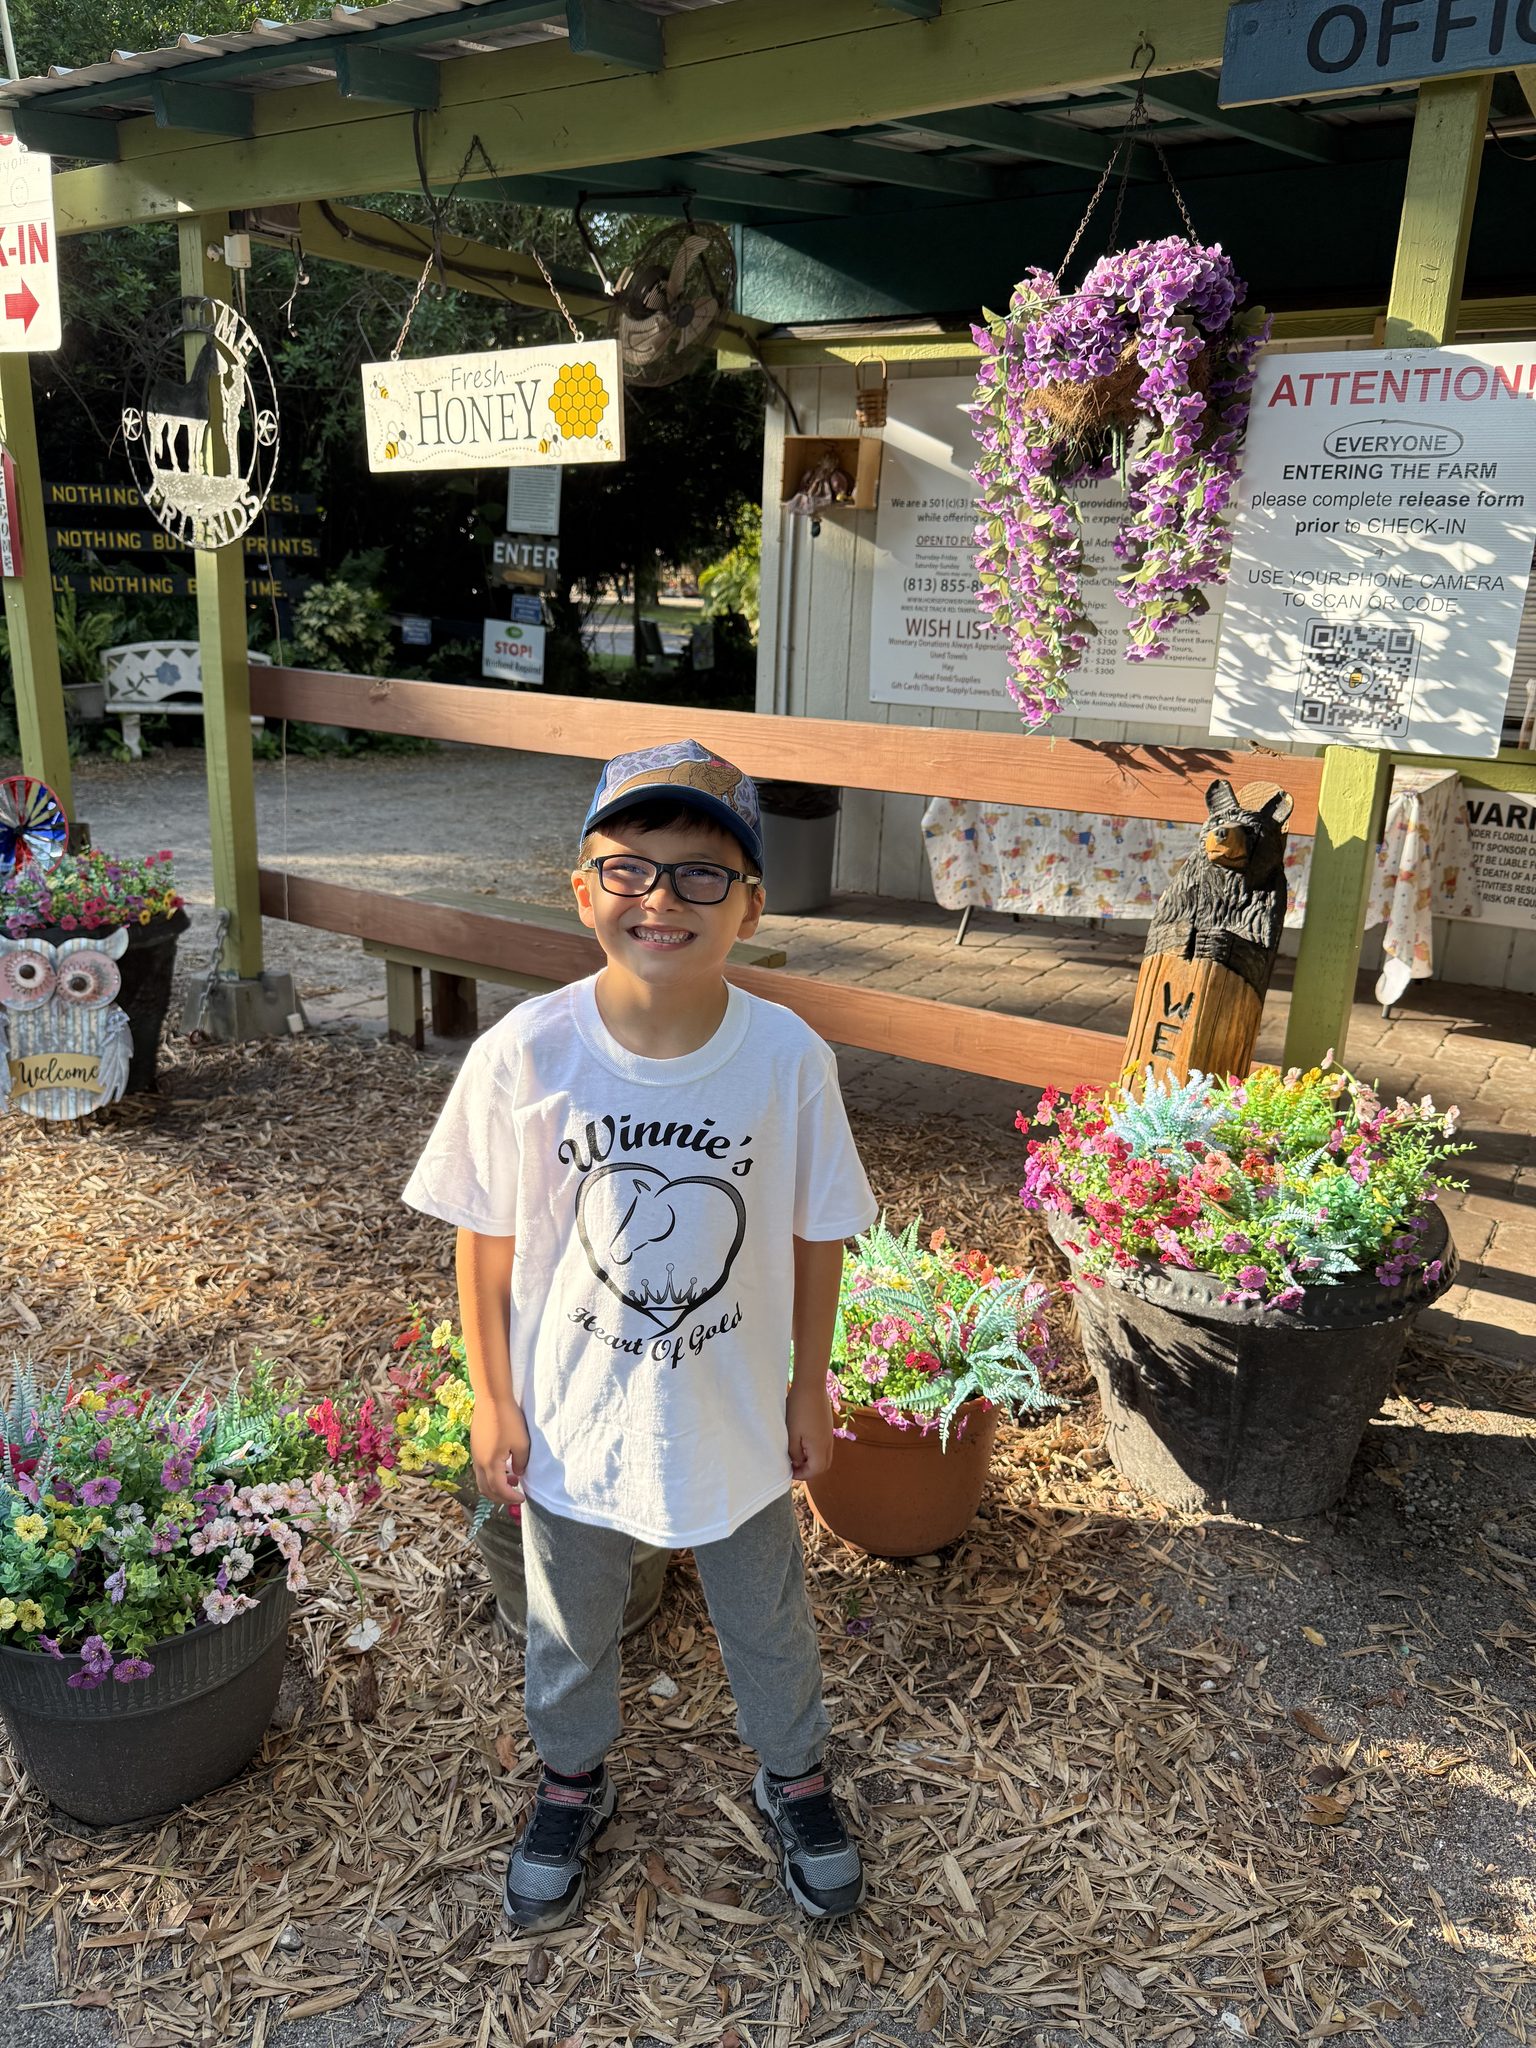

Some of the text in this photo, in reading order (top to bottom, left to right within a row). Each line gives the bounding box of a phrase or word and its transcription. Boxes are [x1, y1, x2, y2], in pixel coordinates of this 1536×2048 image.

[451, 360, 506, 391] Fresh
[1267, 364, 1536, 408] ATTENTION!
[414, 379, 542, 446] HONEY
[1335, 435, 1448, 453] EVERYONE
[1283, 462, 1498, 480] ENTERING THE FARM
[52, 485, 139, 506] NOTHING
[1251, 491, 1525, 509] please complete release form
[1081, 499, 1129, 511] providing
[917, 514, 942, 523] while
[943, 514, 978, 526] offering
[1295, 518, 1467, 535] prior to CHECK-IN
[57, 530, 142, 549] NOTHING
[916, 535, 946, 546] OPEN
[947, 536, 958, 546] TO
[493, 541, 559, 570] ENTER
[90, 576, 174, 595] NOTHING
[903, 577, 937, 594] (813)
[1248, 569, 1505, 591] USE YOUR PHONE CAMERA
[1282, 592, 1458, 613] TO SCAN QR CODE
[905, 617, 951, 639] WISH
[495, 641, 533, 659] STOP!
[1493, 830, 1529, 842] FLORIDA
[1486, 843, 1527, 857] SPONSOR
[1485, 855, 1497, 865] BE
[1498, 857, 1528, 869] LIABLE
[1482, 868, 1511, 880] DEATH
[1511, 870, 1523, 881] OF
[1482, 892, 1502, 903] RISK
[1503, 895, 1516, 906] OR
[18, 1057, 99, 1088] Welcome
[558, 1114, 755, 1177] Winnie's
[567, 1301, 743, 1369] Heart Of Gold
